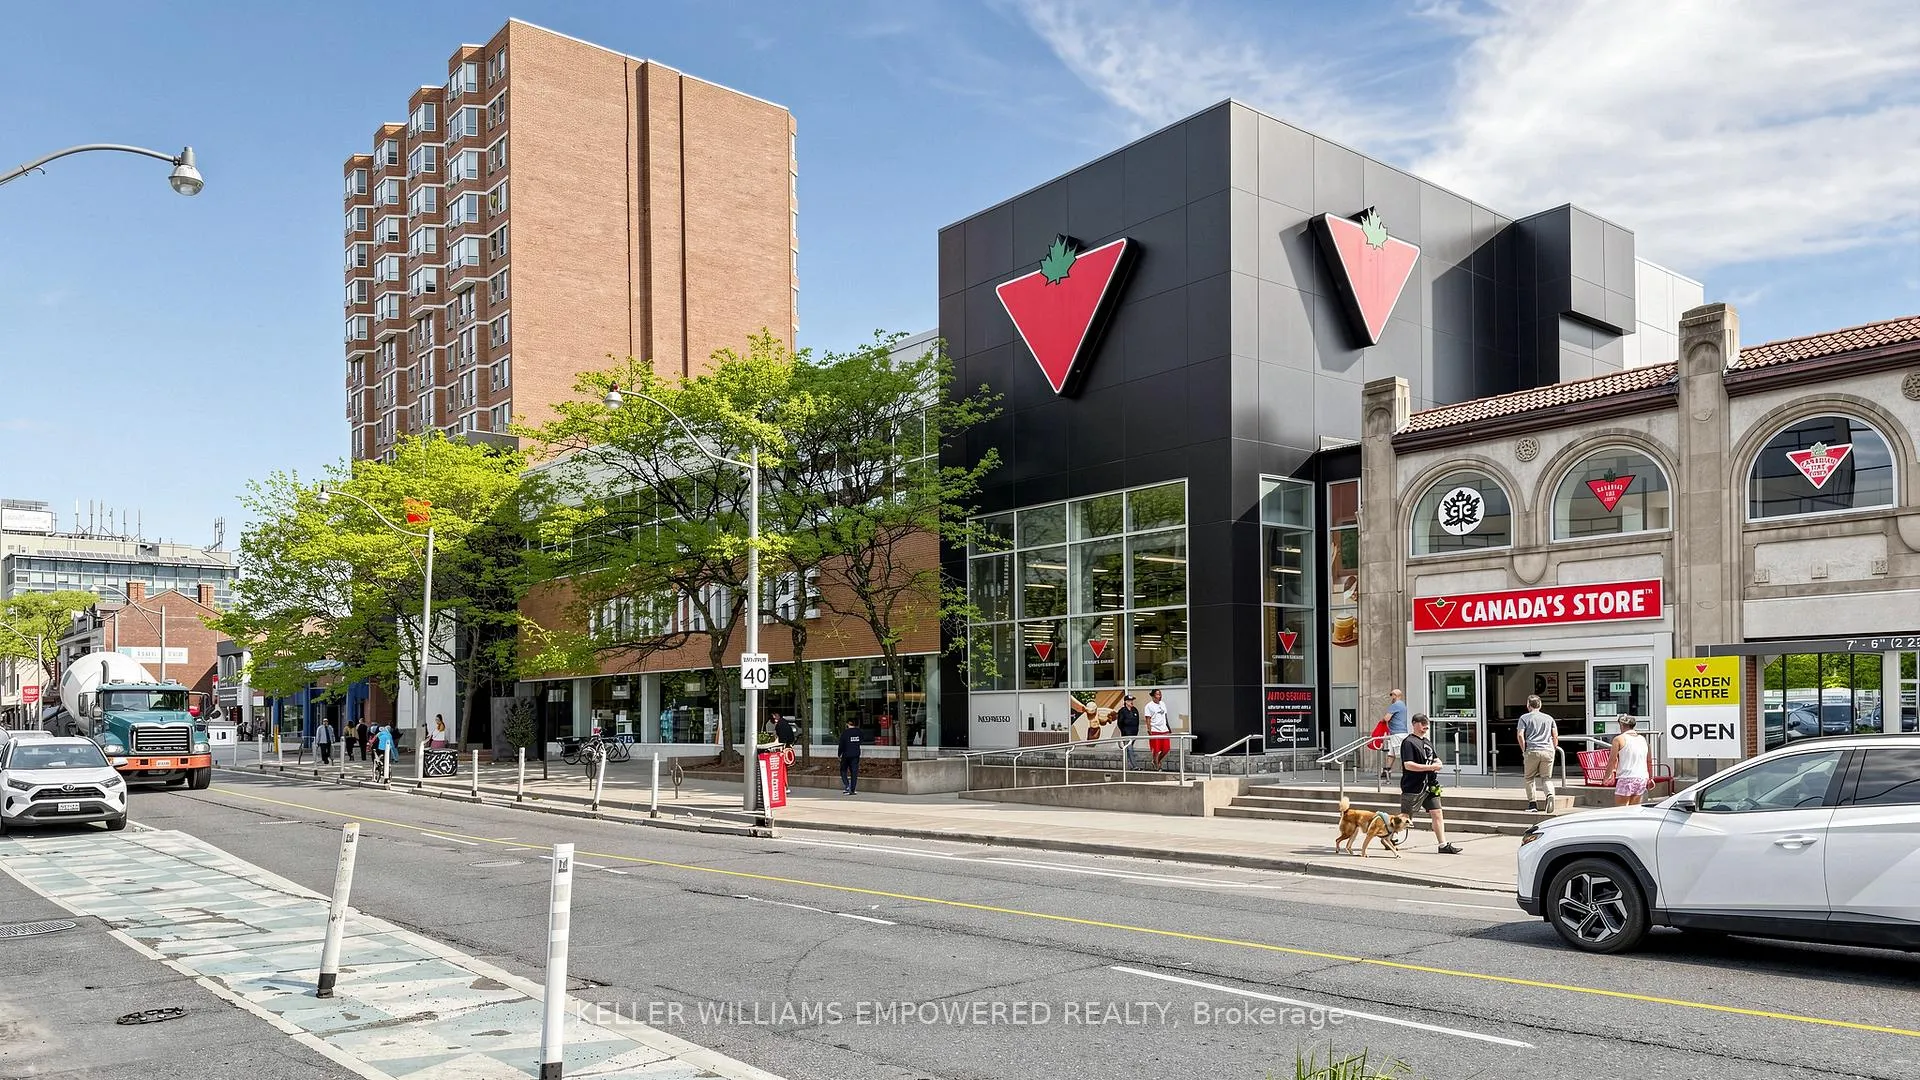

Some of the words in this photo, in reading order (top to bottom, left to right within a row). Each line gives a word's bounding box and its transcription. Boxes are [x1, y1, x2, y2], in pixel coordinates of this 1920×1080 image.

[1461, 594, 1565, 622] CANADA'S
[744, 667, 767, 684] 40
[1673, 677, 1730, 688] GARDEN
[1675, 688, 1729, 699] CENTRE
[1671, 723, 1734, 740] OPEN
